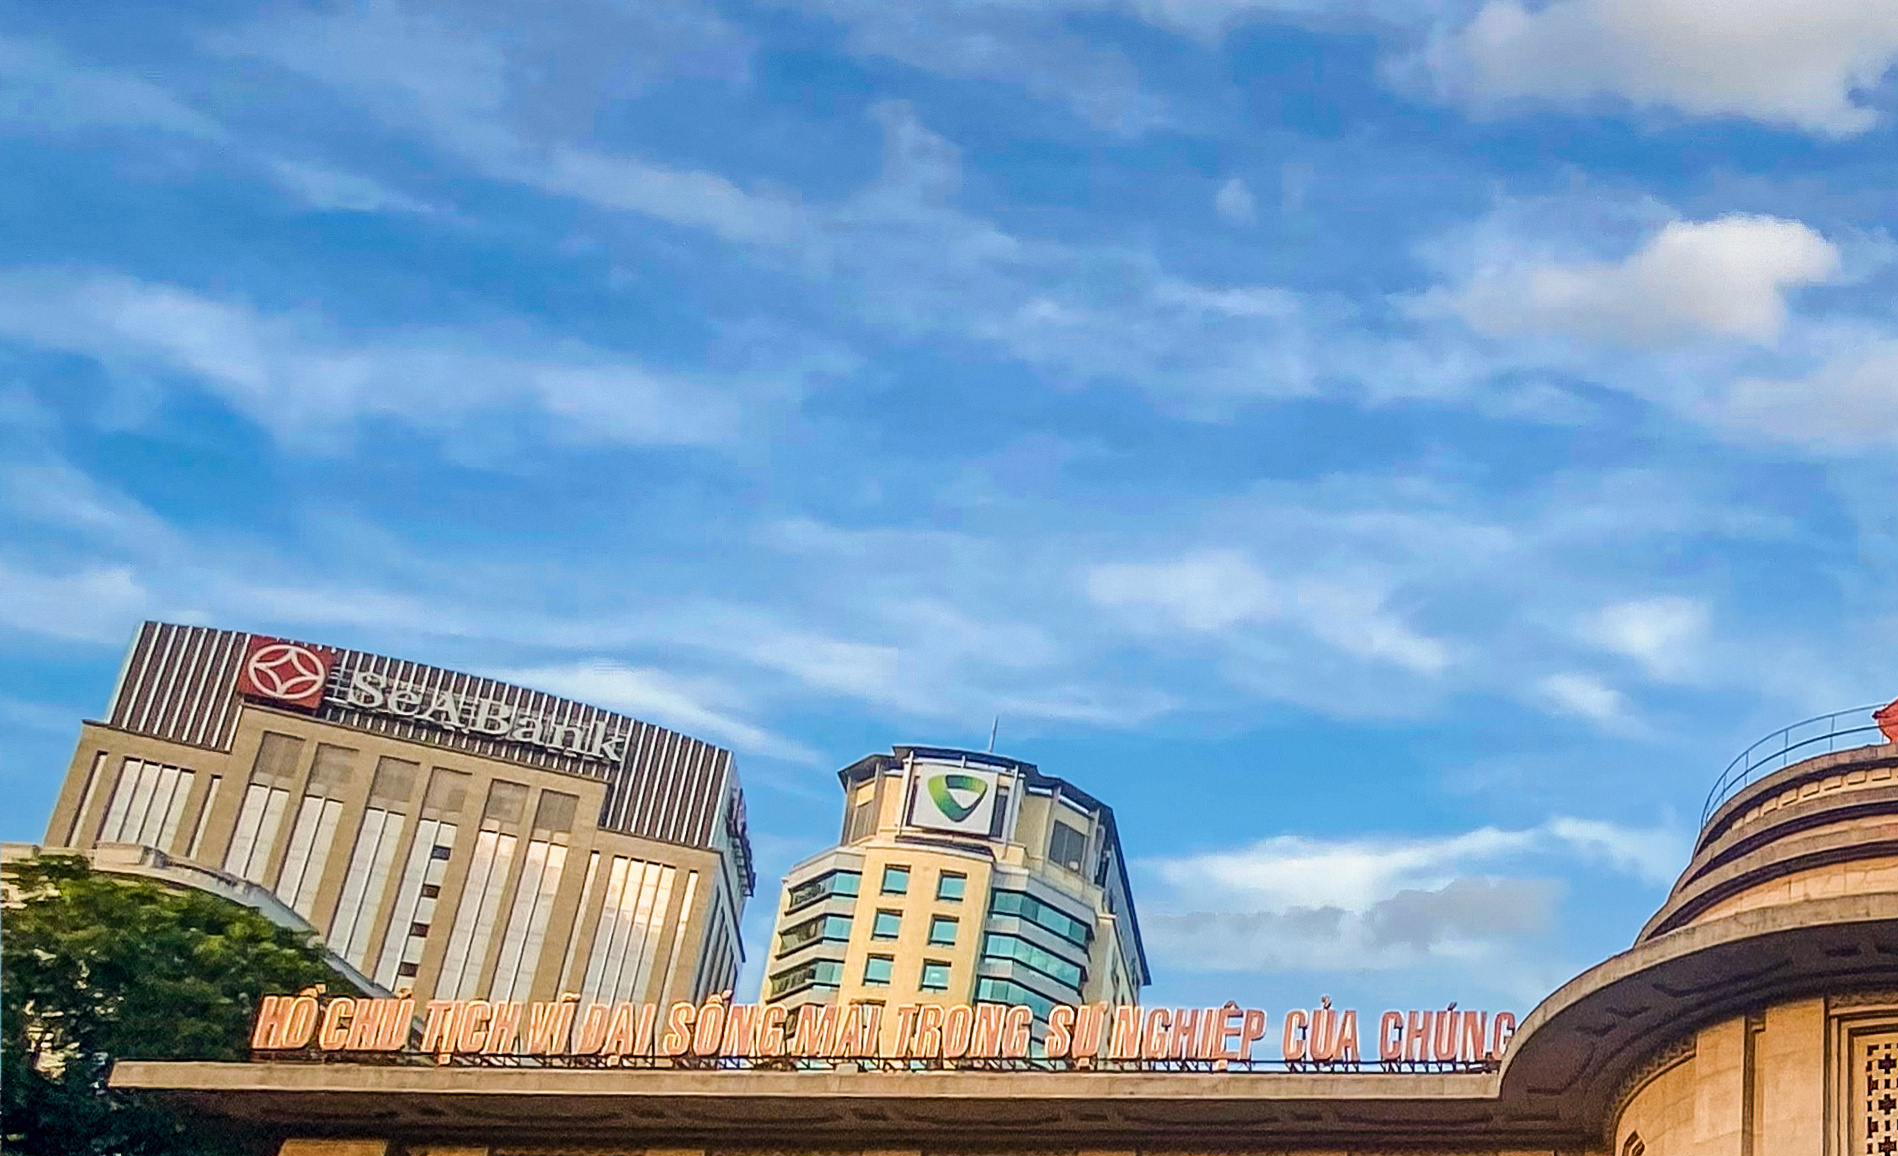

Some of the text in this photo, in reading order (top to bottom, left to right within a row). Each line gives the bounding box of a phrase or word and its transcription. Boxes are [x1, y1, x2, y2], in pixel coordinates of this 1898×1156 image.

[349, 671, 627, 763] SeABank
[252, 982, 326, 1050] HỒ
[420, 1000, 521, 1066] TỊCH
[527, 992, 581, 1055] VĨ
[664, 990, 787, 1057] SỐNG
[896, 1003, 1033, 1058] TRONG
[1108, 1000, 1266, 1070] NGHIỆP
[1283, 995, 1360, 1061] CỦA
